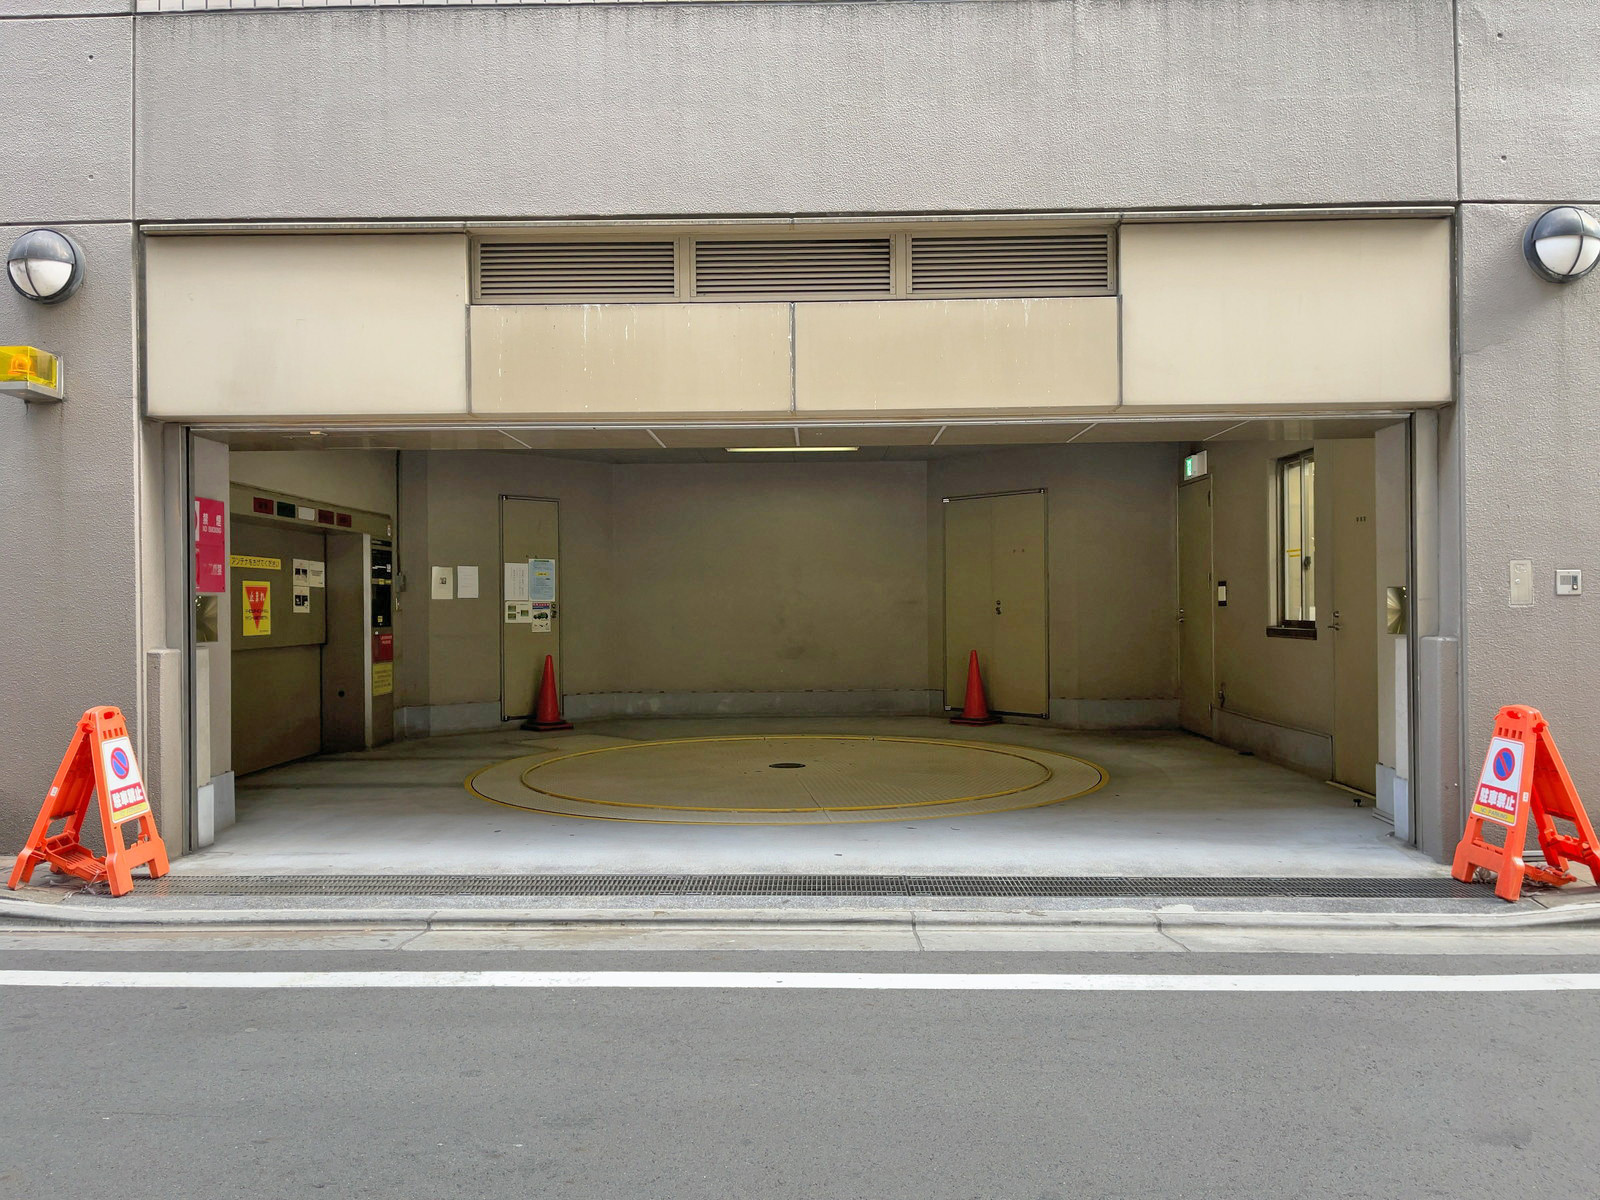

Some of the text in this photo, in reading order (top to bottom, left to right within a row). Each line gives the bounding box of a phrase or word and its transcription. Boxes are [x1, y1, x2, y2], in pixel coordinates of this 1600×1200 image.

[112, 785, 144, 809] 駐車禁止
[1479, 787, 1515, 811] 駐車禁止
